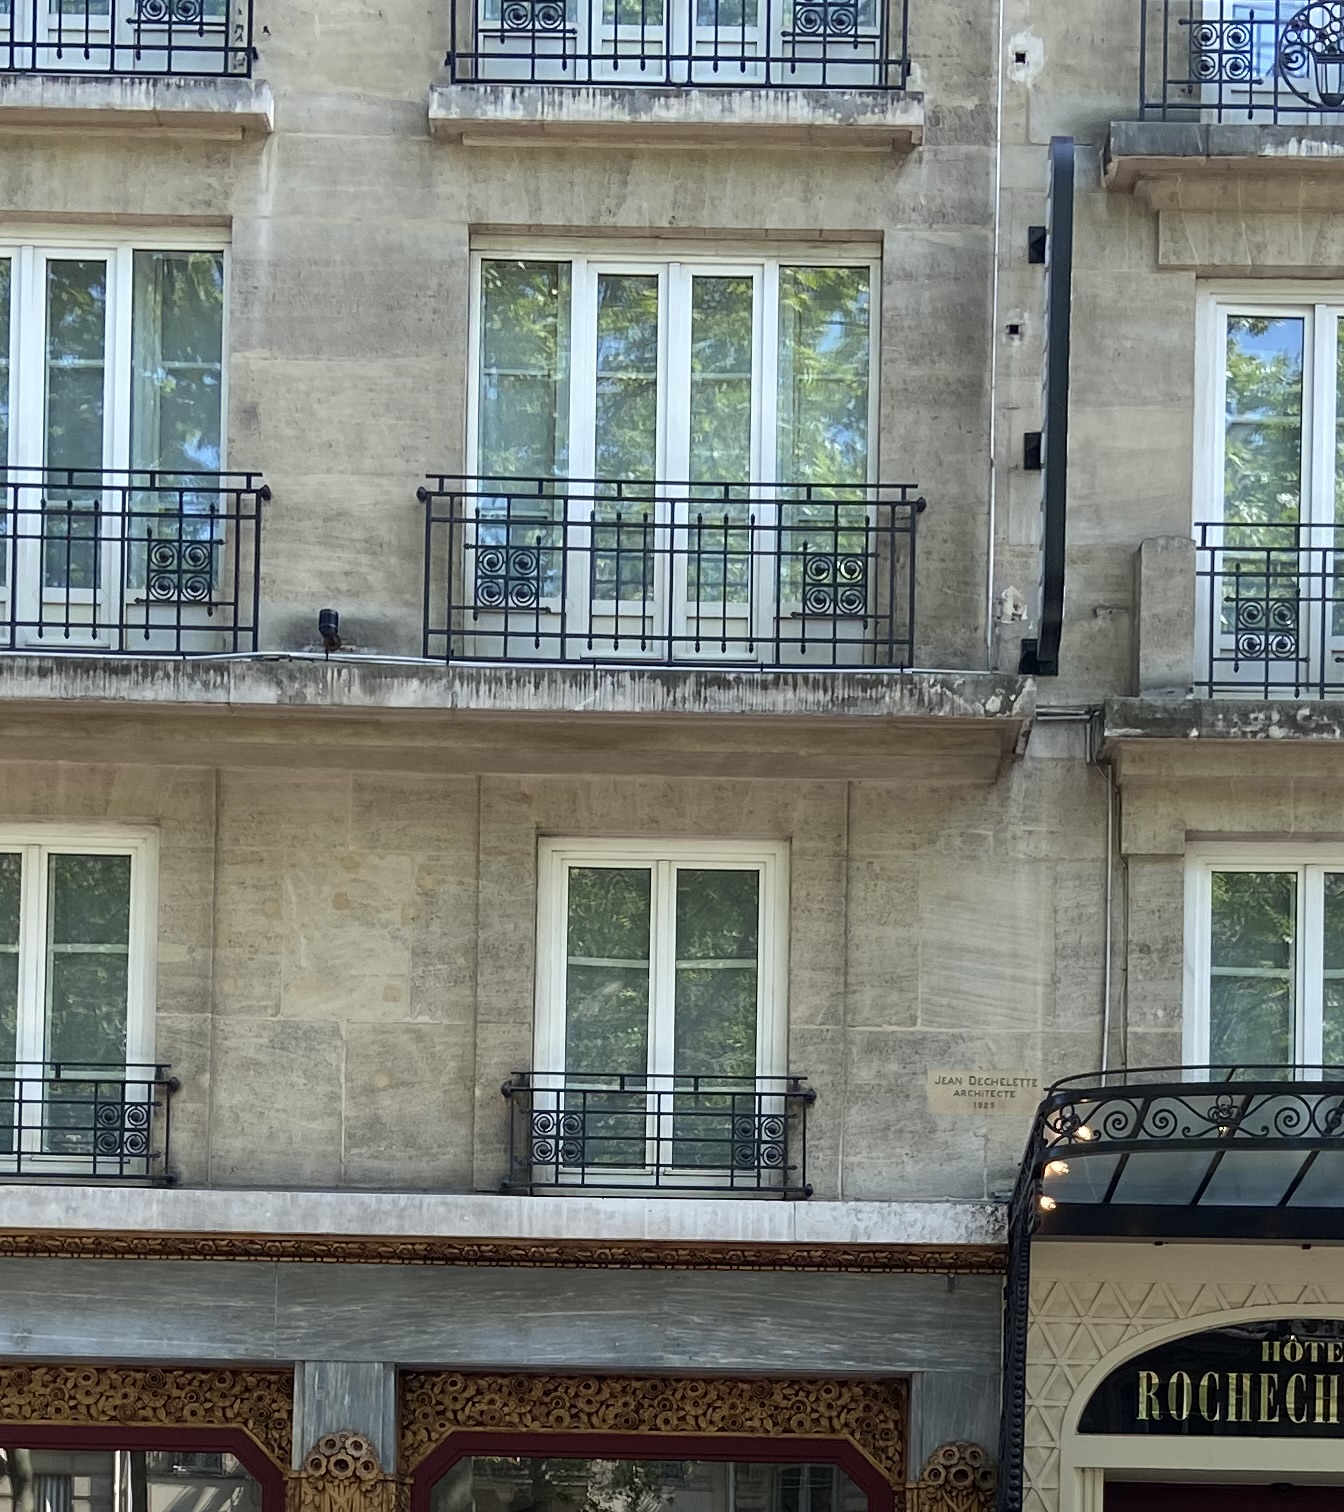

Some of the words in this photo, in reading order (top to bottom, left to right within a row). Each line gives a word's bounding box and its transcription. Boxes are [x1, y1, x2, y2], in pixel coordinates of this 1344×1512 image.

[934, 1075, 962, 1086] JEAN
[968, 1075, 1038, 1088] DECHELETTE
[953, 1089, 1016, 1099] ARCHITECTE
